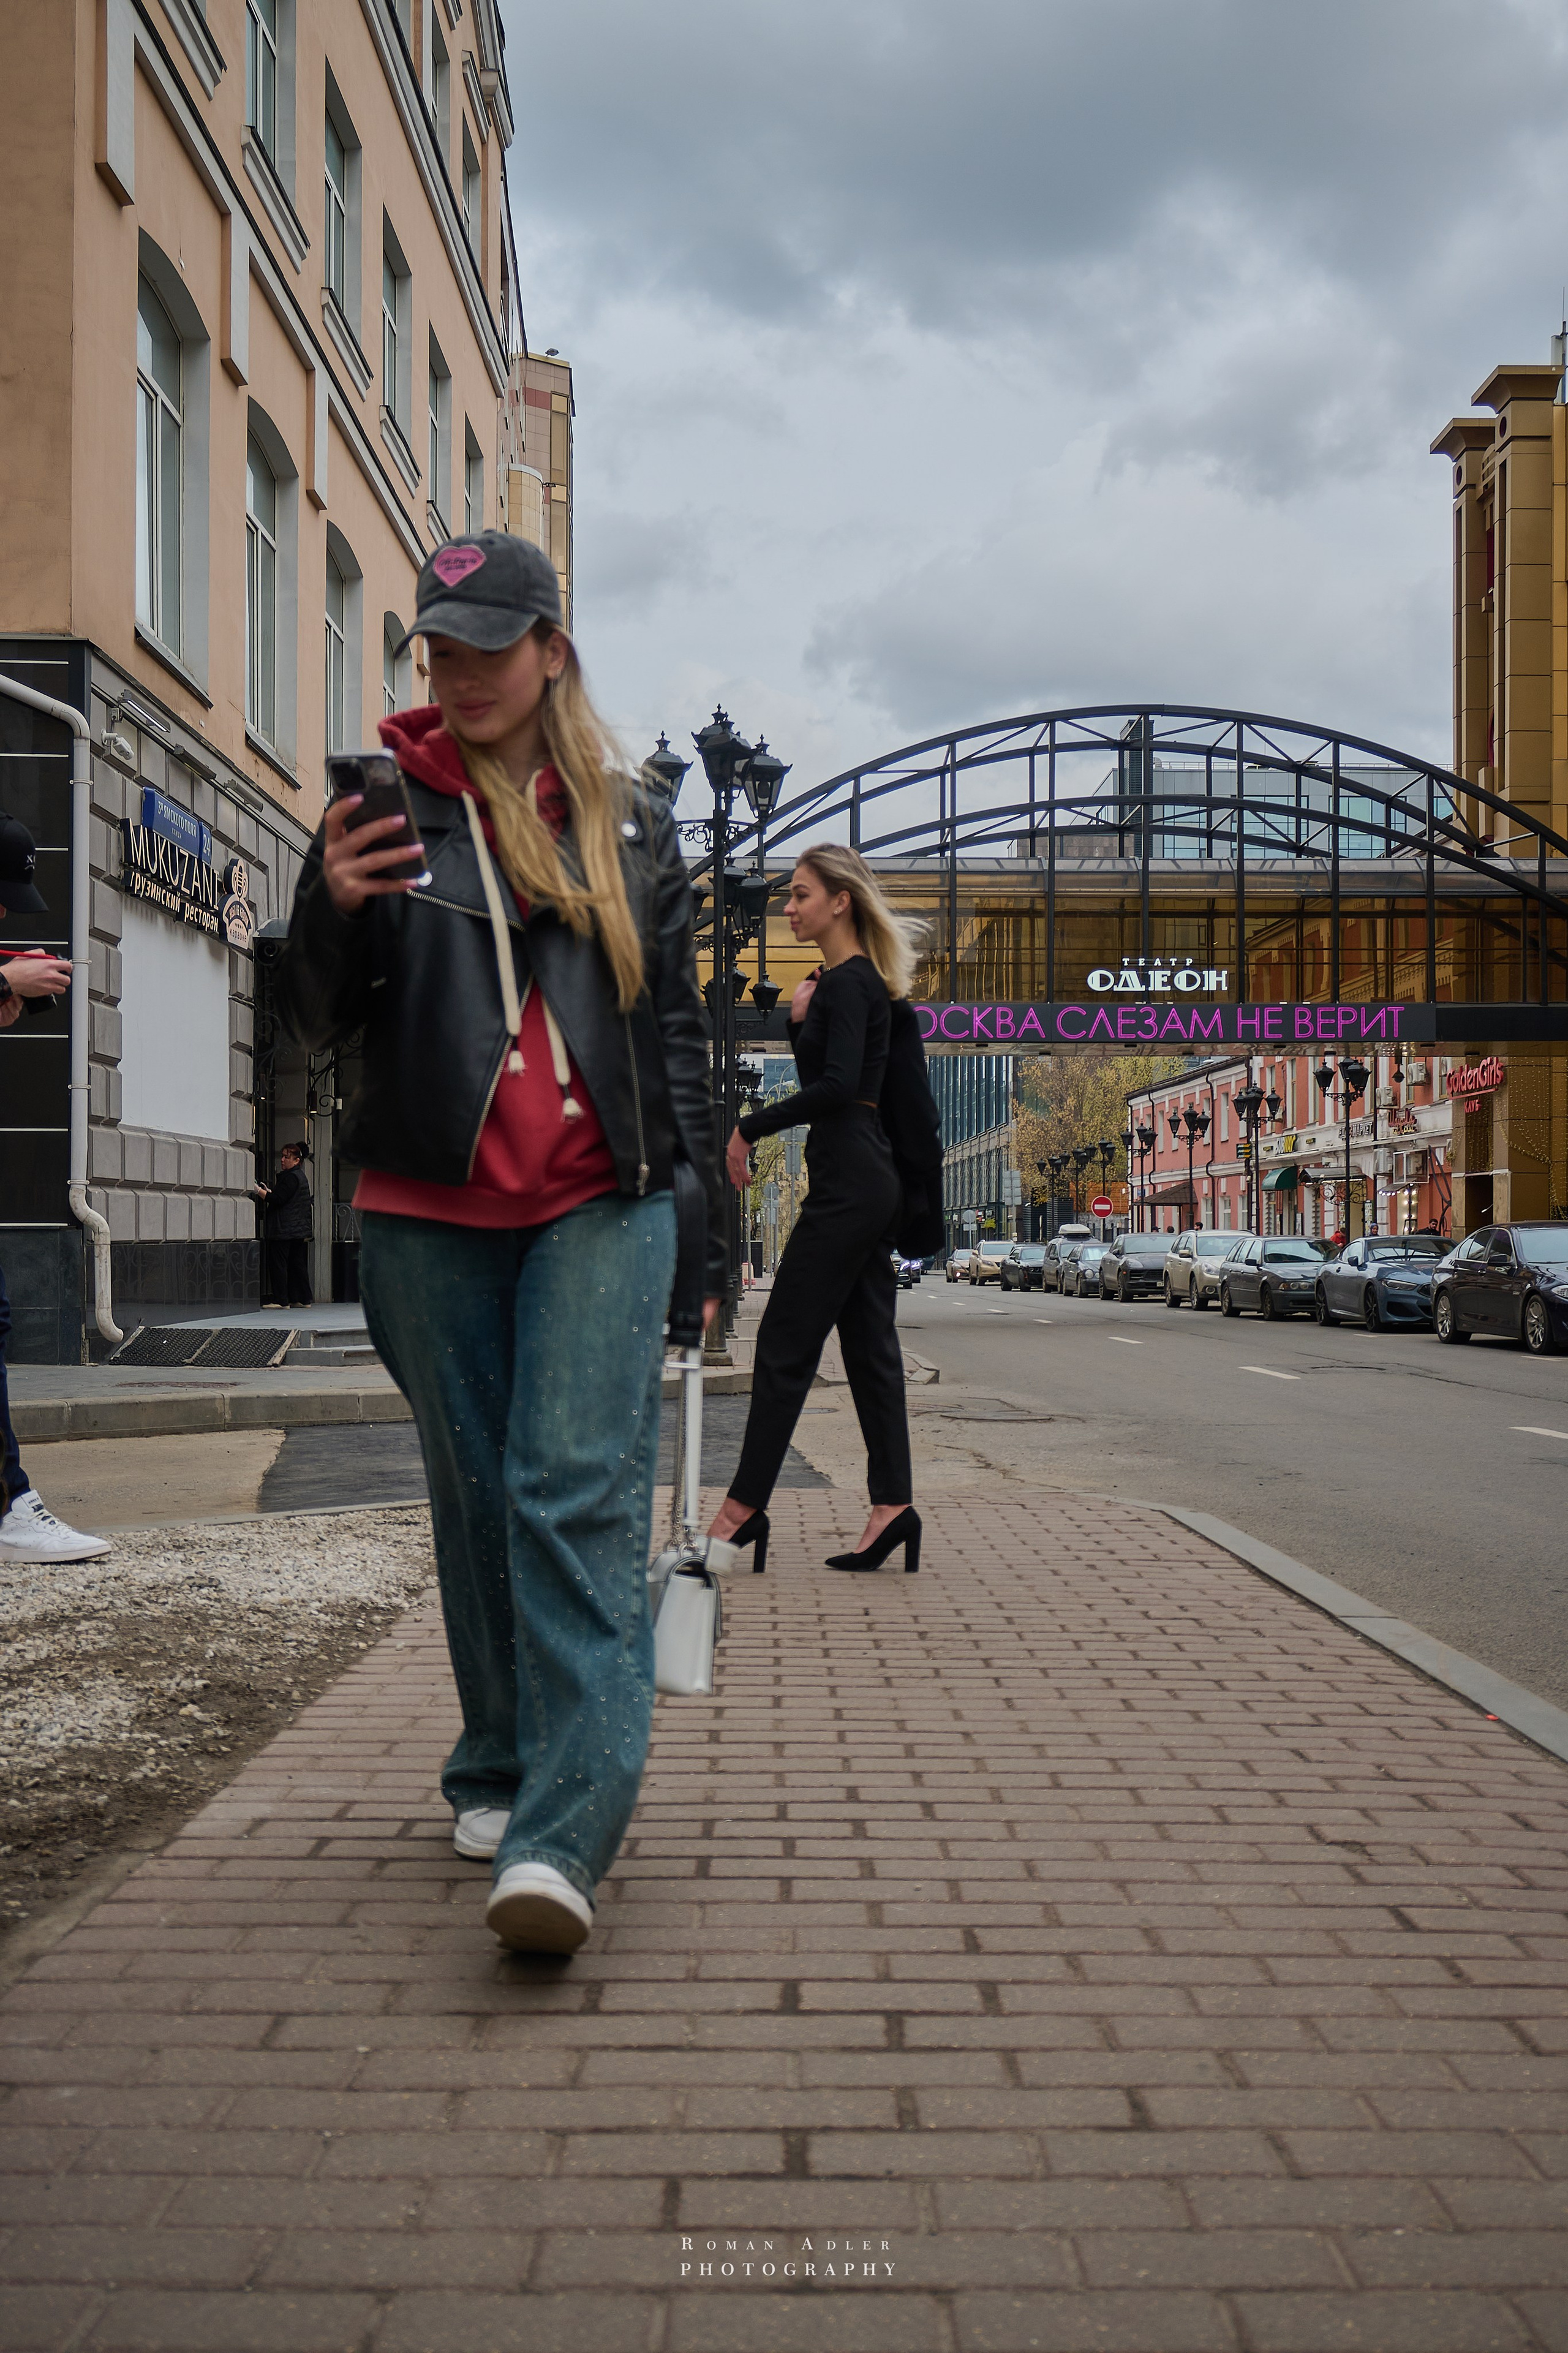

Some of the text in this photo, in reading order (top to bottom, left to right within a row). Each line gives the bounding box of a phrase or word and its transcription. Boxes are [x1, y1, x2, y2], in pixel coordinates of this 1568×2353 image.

[164, 805, 184, 829] ЯМСКОГО
[184, 821, 197, 838] ПОЛЯ
[203, 834, 211, 856] 24
[129, 817, 219, 910] MUKUZANI
[130, 871, 181, 913] грузинский
[184, 902, 219, 932] ресторан
[229, 929, 247, 943] караоке
[1087, 970, 1228, 992] ОДЕОН
[913, 1006, 1404, 1039] ОСКВА СЛЕЗАМ НЕ ВЕРИТ
[1464, 1099, 1481, 1113] КЛУБ
[1352, 1121, 1373, 1137] МАРКЕТ
